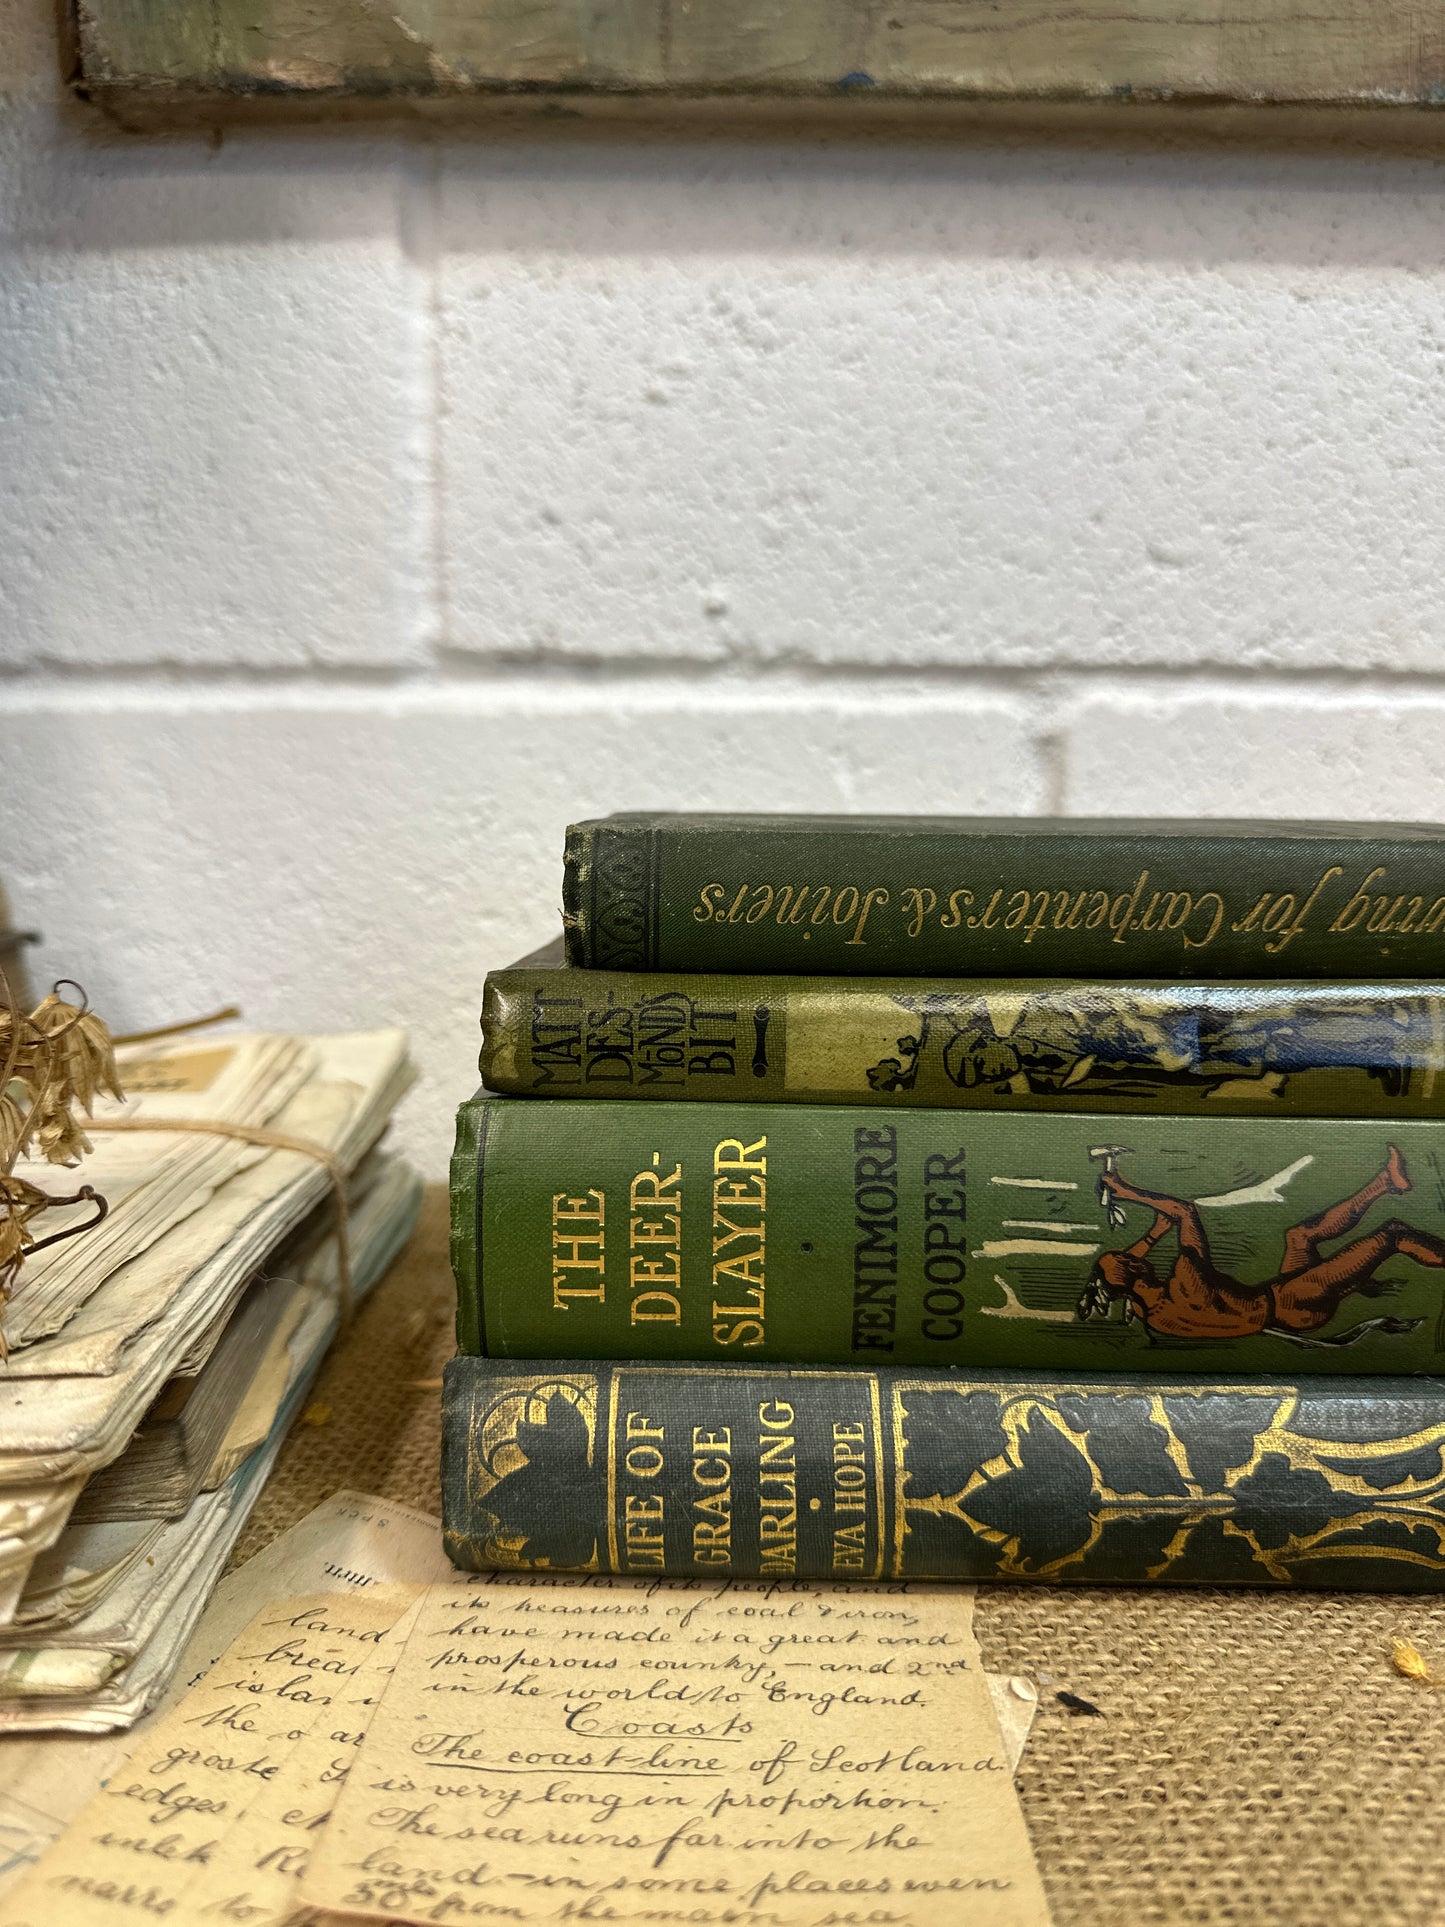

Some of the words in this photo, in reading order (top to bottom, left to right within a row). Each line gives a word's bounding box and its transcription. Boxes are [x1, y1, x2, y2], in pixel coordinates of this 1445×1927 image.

[693, 882, 890, 944] Joiners
[900, 887, 938, 937] &
[941, 870, 1224, 948] Carpenters
[1232, 867, 1343, 952] for
[531, 988, 584, 1088] MATT
[585, 990, 635, 1085] DES-
[688, 1000, 737, 1076] BIT
[552, 1188, 605, 1310] THE
[630, 1151, 683, 1327] DEER-
[712, 1135, 768, 1347] SLAYER
[850, 1124, 898, 1354] FENIMORE
[922, 1147, 967, 1342] COOPER
[625, 1411, 665, 1478] OF
[832, 1421, 866, 1513] HOPE
[692, 1425, 732, 1567] GRACE
[759, 1397, 797, 1576] DARLING
[625, 1495, 665, 1569] LIFE
[832, 1521, 866, 1569] EVA
[500, 1596, 651, 1616] treasures
[665, 1597, 712, 1628] of
[716, 1601, 805, 1618] coal
[832, 1581, 916, 1594] and
[262, 1607, 391, 1643] land
[428, 1615, 546, 1637] have
[562, 1626, 674, 1643] made
[733, 1632, 758, 1644] a
[758, 1629, 866, 1654] great
[877, 1632, 960, 1645] and
[426, 1648, 618, 1672] prosperous
[819, 1657, 896, 1675] and
[184, 1702, 261, 1732] the
[422, 1673, 480, 1694] in
[487, 1674, 548, 1697] the
[551, 1678, 694, 1701] world
[690, 1684, 748, 1704] to
[761, 1680, 927, 1716] England.
[563, 1701, 753, 1735] Coasts
[411, 1729, 487, 1761] The
[749, 1739, 802, 1786] of
[370, 1774, 417, 1795] is
[434, 1780, 524, 1819] very
[525, 1780, 630, 1823] long
[635, 1781, 697, 1806] in
[369, 1803, 445, 1836] The
[443, 1826, 529, 1844] sea
[528, 1831, 644, 1849] runs
[648, 1816, 732, 1868] far
[733, 1823, 850, 1851] into
[848, 1822, 935, 1854] the
[343, 1845, 497, 1885] land
[598, 1874, 740, 1892] some
[744, 1869, 892, 1908] places
[902, 1875, 1013, 1892] even
[550, 1895, 623, 1922] the
